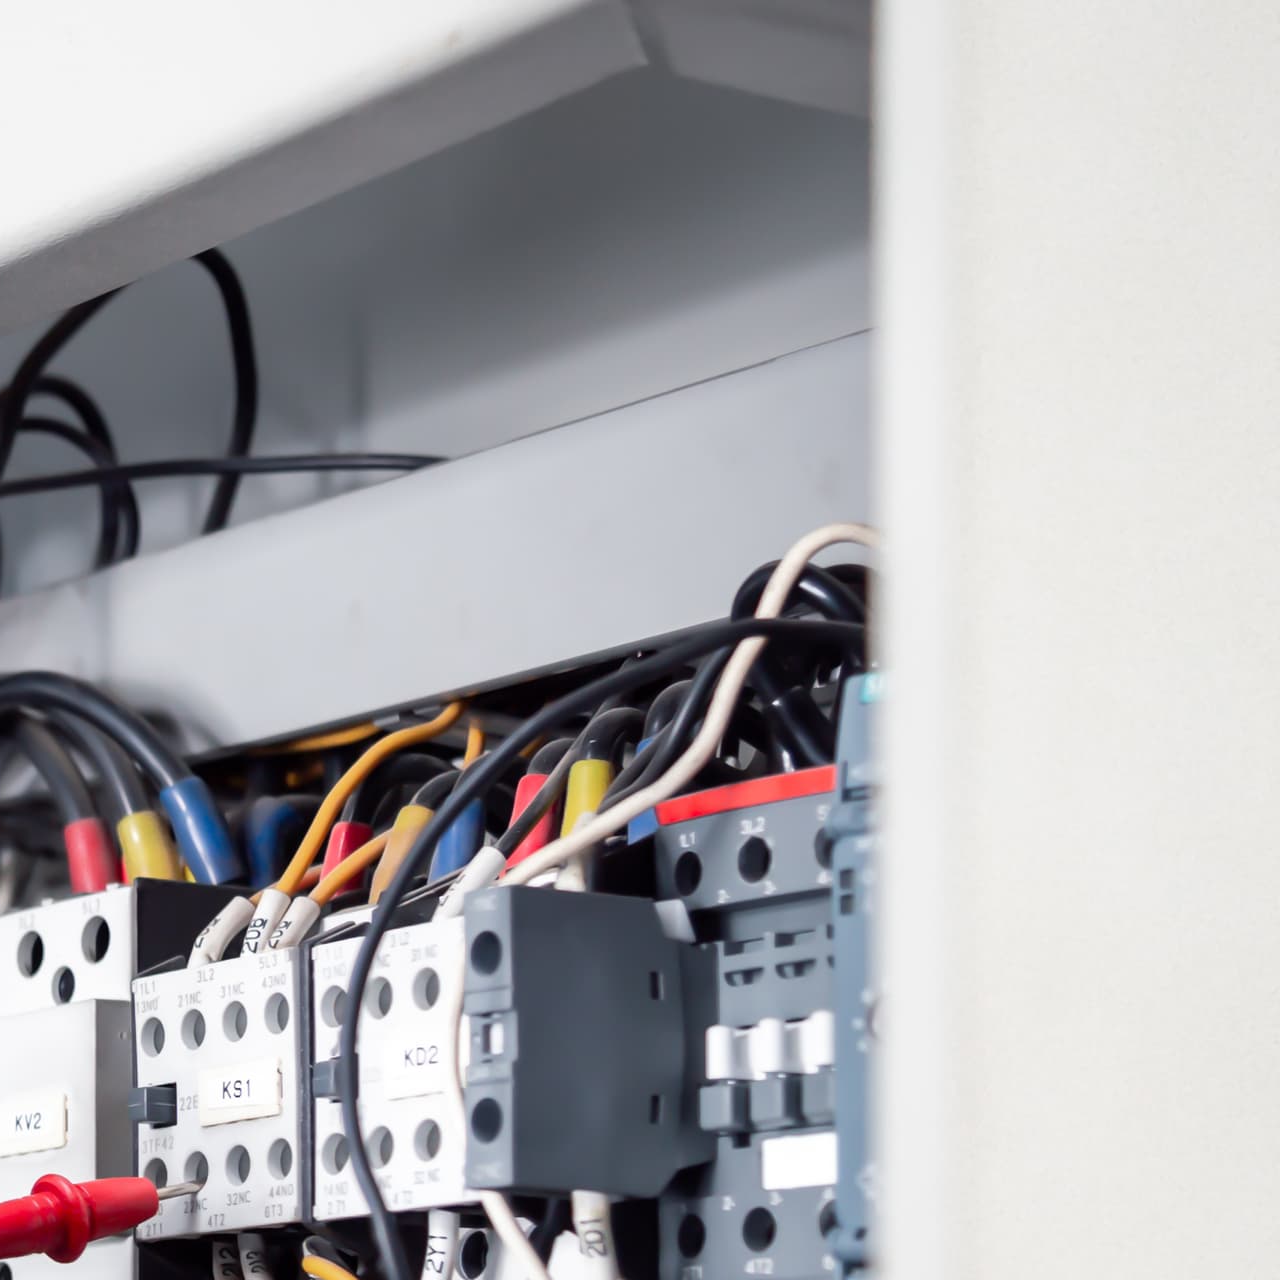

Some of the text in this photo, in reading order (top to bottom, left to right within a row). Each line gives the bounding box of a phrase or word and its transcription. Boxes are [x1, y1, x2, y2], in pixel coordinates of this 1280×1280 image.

[404, 1045, 439, 1067] KD2
[222, 1079, 251, 1099] KS1
[15, 1112, 42, 1131] KV2
[425, 1235, 448, 1274] 2Y1
